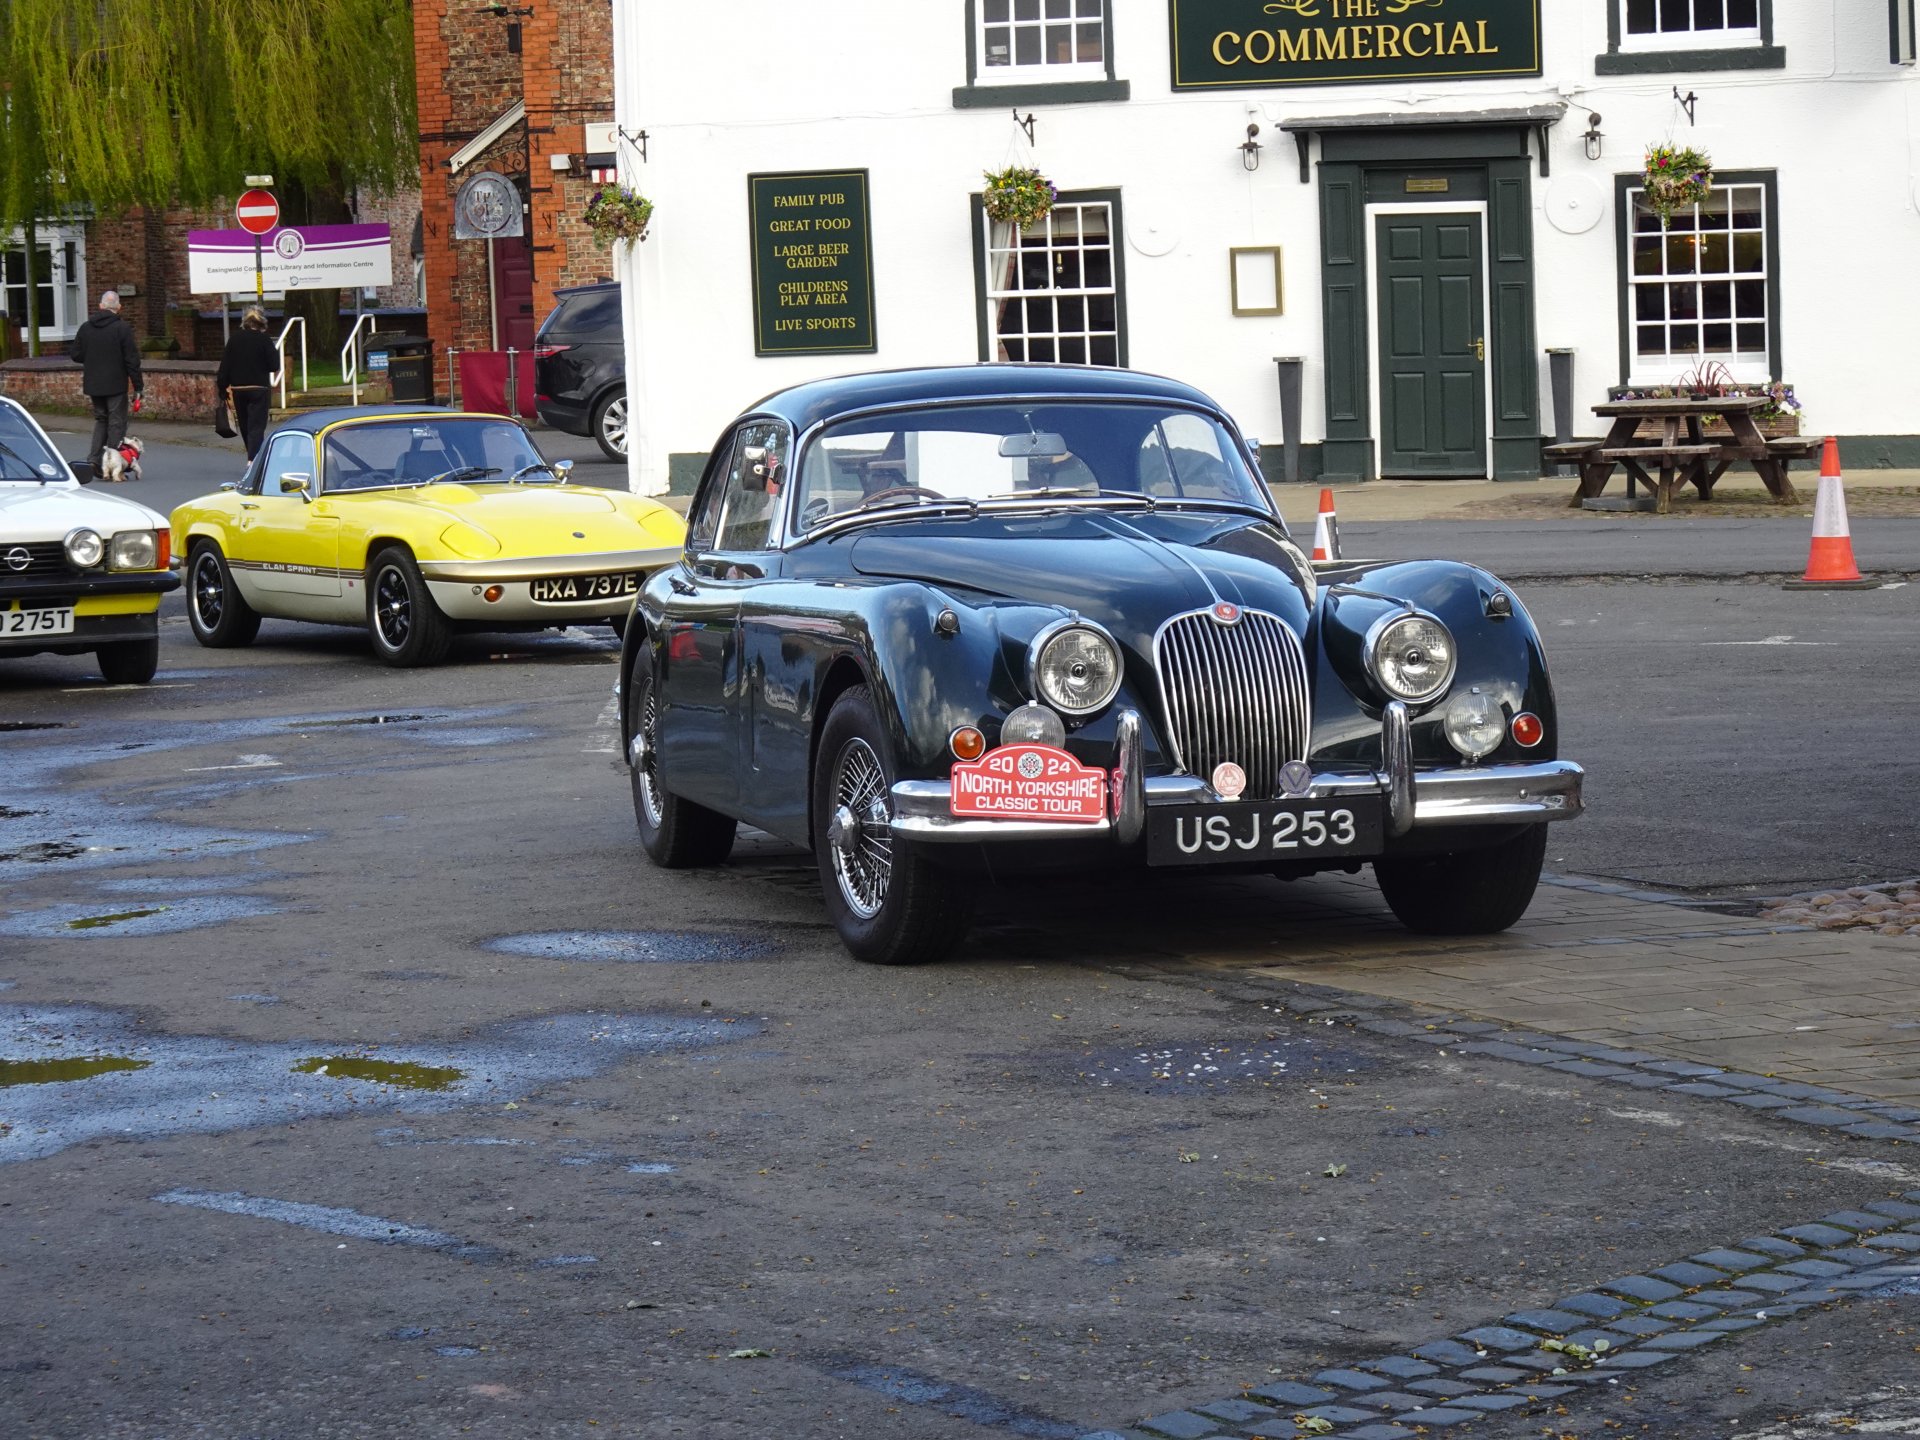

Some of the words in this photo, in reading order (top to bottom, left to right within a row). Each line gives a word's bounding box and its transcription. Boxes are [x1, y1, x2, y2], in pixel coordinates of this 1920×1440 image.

[1331, 0, 1380, 18] THE
[1212, 20, 1499, 66] COMMERCIAL
[773, 194, 815, 208] FAMILY
[819, 193, 845, 206] PUB
[769, 219, 811, 232] GREAT
[815, 218, 851, 230] FOOD
[774, 244, 815, 257] LARGE
[818, 242, 849, 255] BEER
[206, 266, 242, 274] Easingwold
[786, 256, 838, 269] GARDEN
[778, 280, 849, 294] CHILDRENS
[780, 294, 810, 306] PLAY
[814, 292, 848, 305] AREA
[775, 319, 803, 331] LIVE
[806, 316, 856, 330] SPORTS
[262, 562, 285, 571] ELAN
[286, 564, 317, 574] SPRINT
[534, 578, 578, 600] HXA
[584, 574, 637, 596] 737E
[10, 610, 70, 633] 275T
[989, 756, 1014, 774] 20
[1048, 758, 1071, 776] 24
[960, 771, 1013, 794] NORTH
[1016, 776, 1098, 798] YORKSHIRE
[975, 796, 1039, 811] CLASSIC
[1042, 798, 1082, 813] TOUR
[1176, 812, 1260, 854] USJ
[1272, 808, 1356, 849] 253
